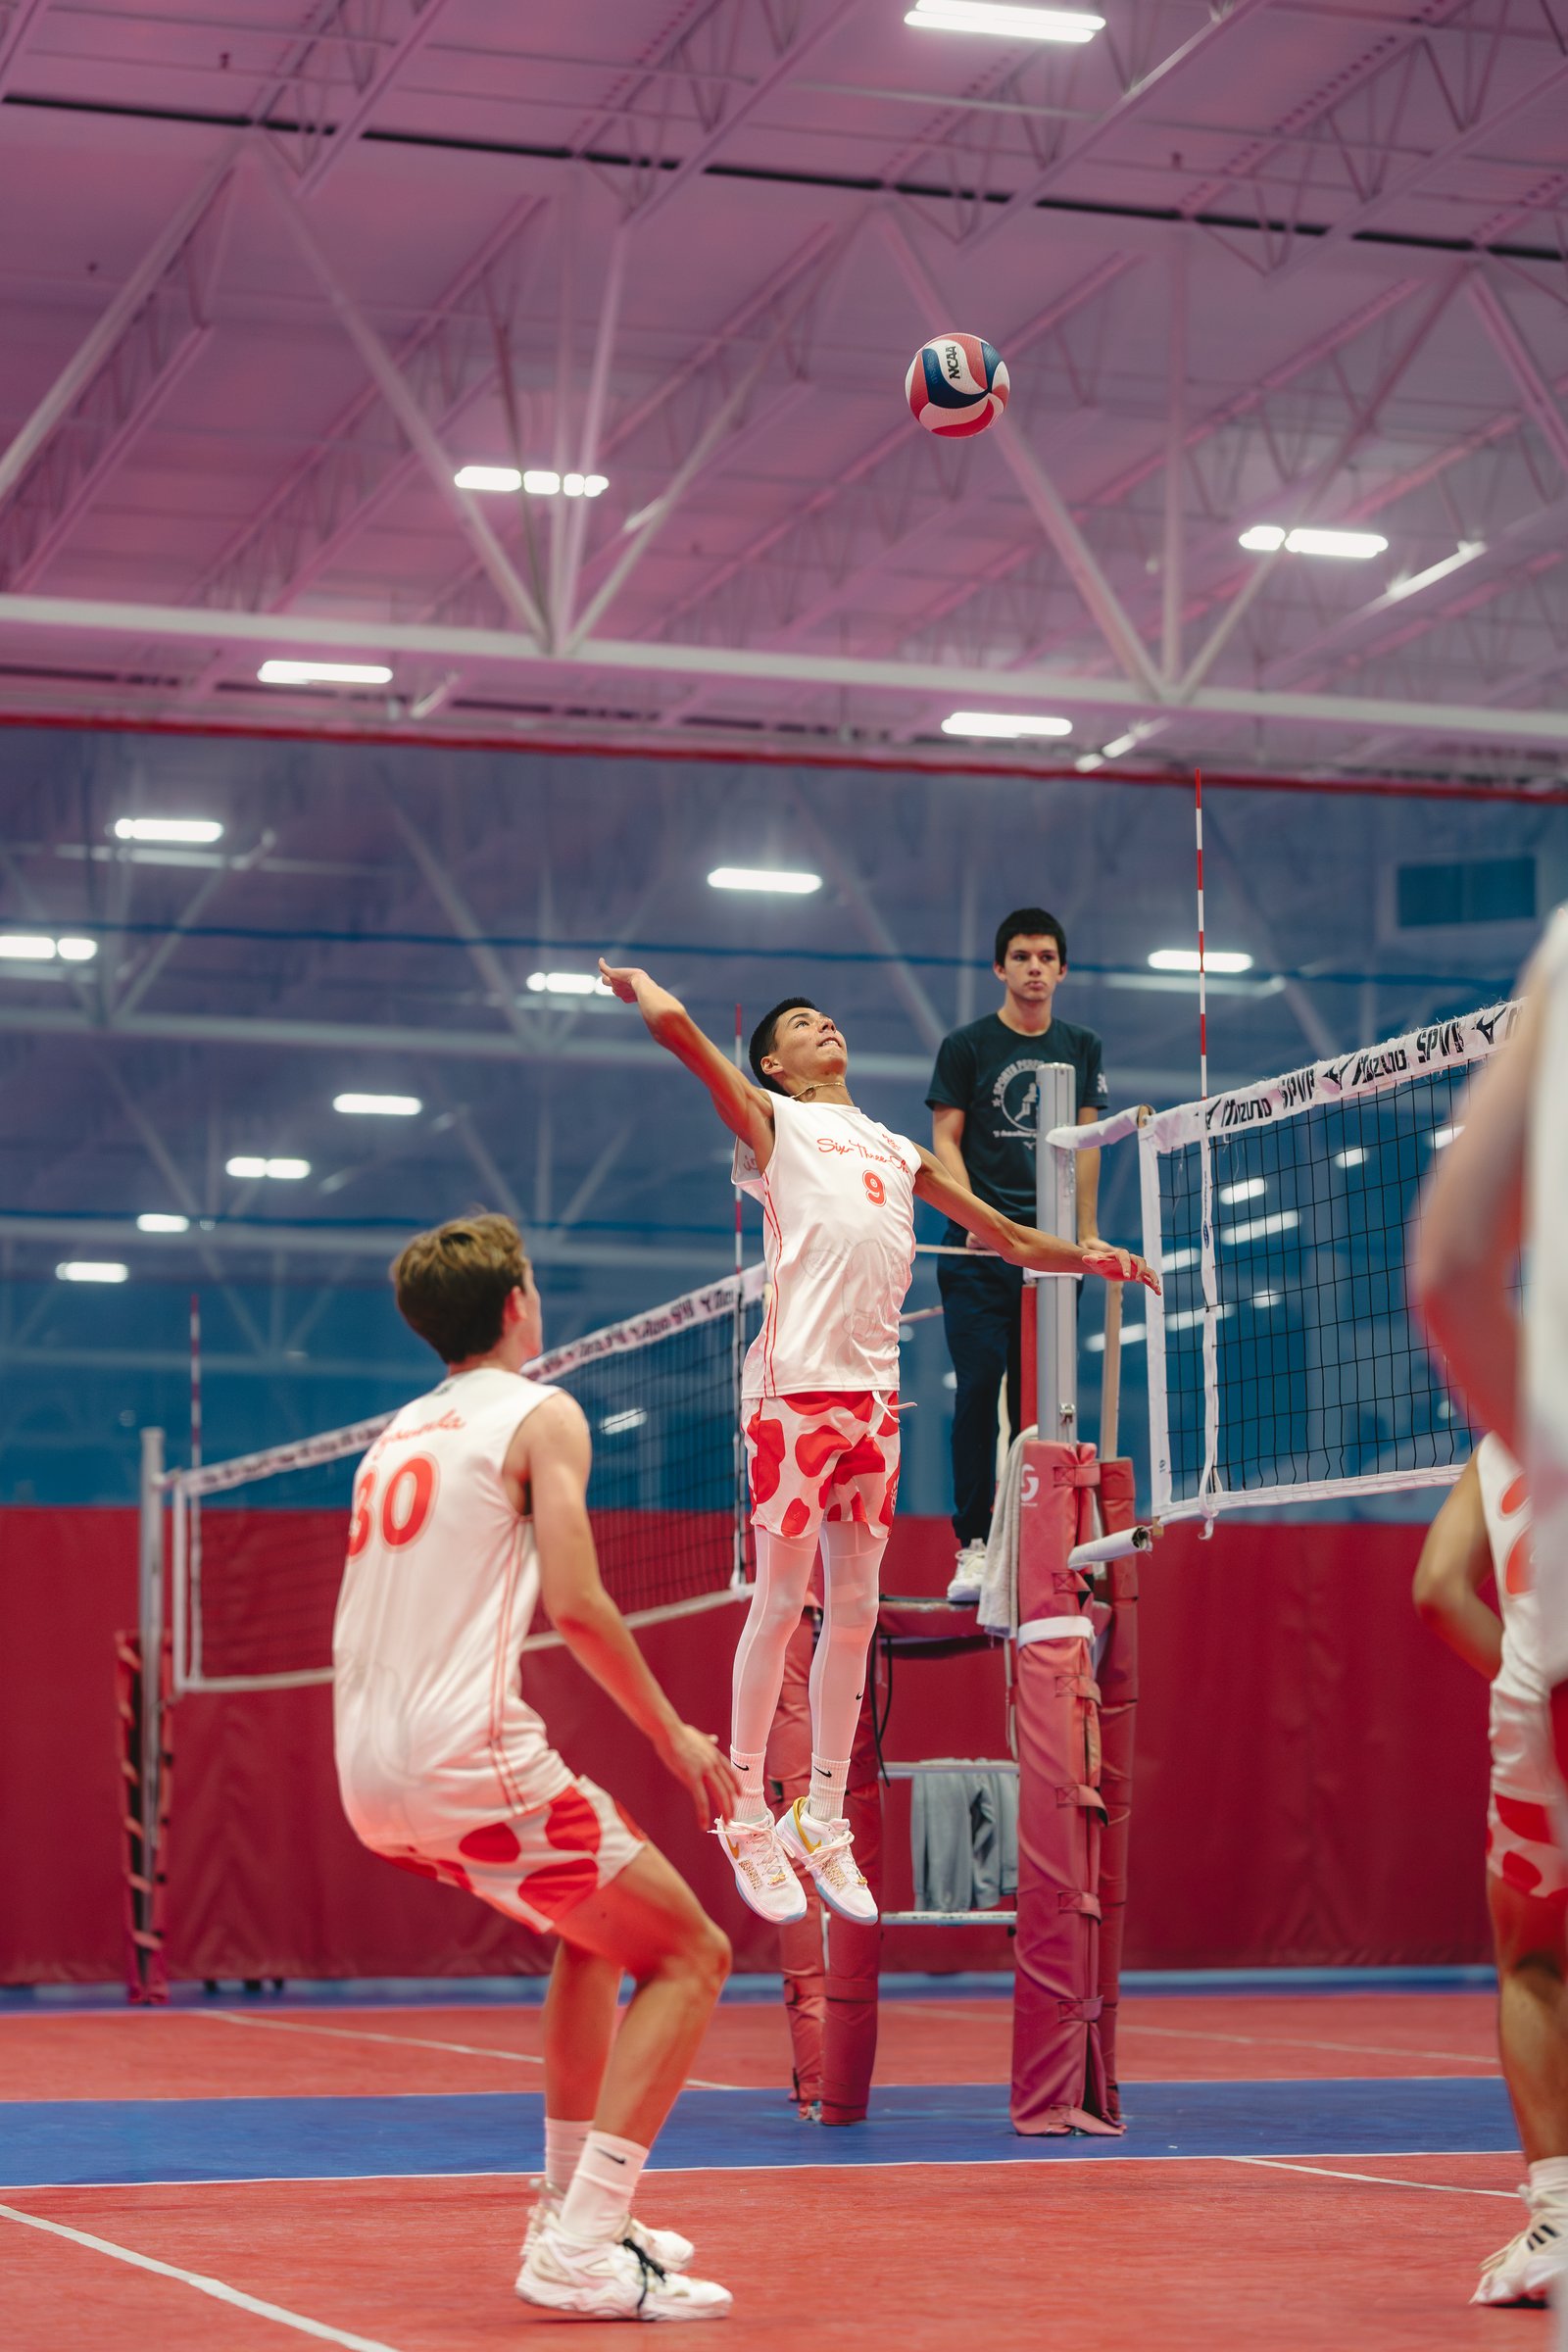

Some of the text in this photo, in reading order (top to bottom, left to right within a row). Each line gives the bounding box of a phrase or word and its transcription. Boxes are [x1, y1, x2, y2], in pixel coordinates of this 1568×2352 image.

[945, 345, 960, 379] NCAA
[862, 1169, 887, 1207] 9
[348, 1451, 440, 1564] 30
